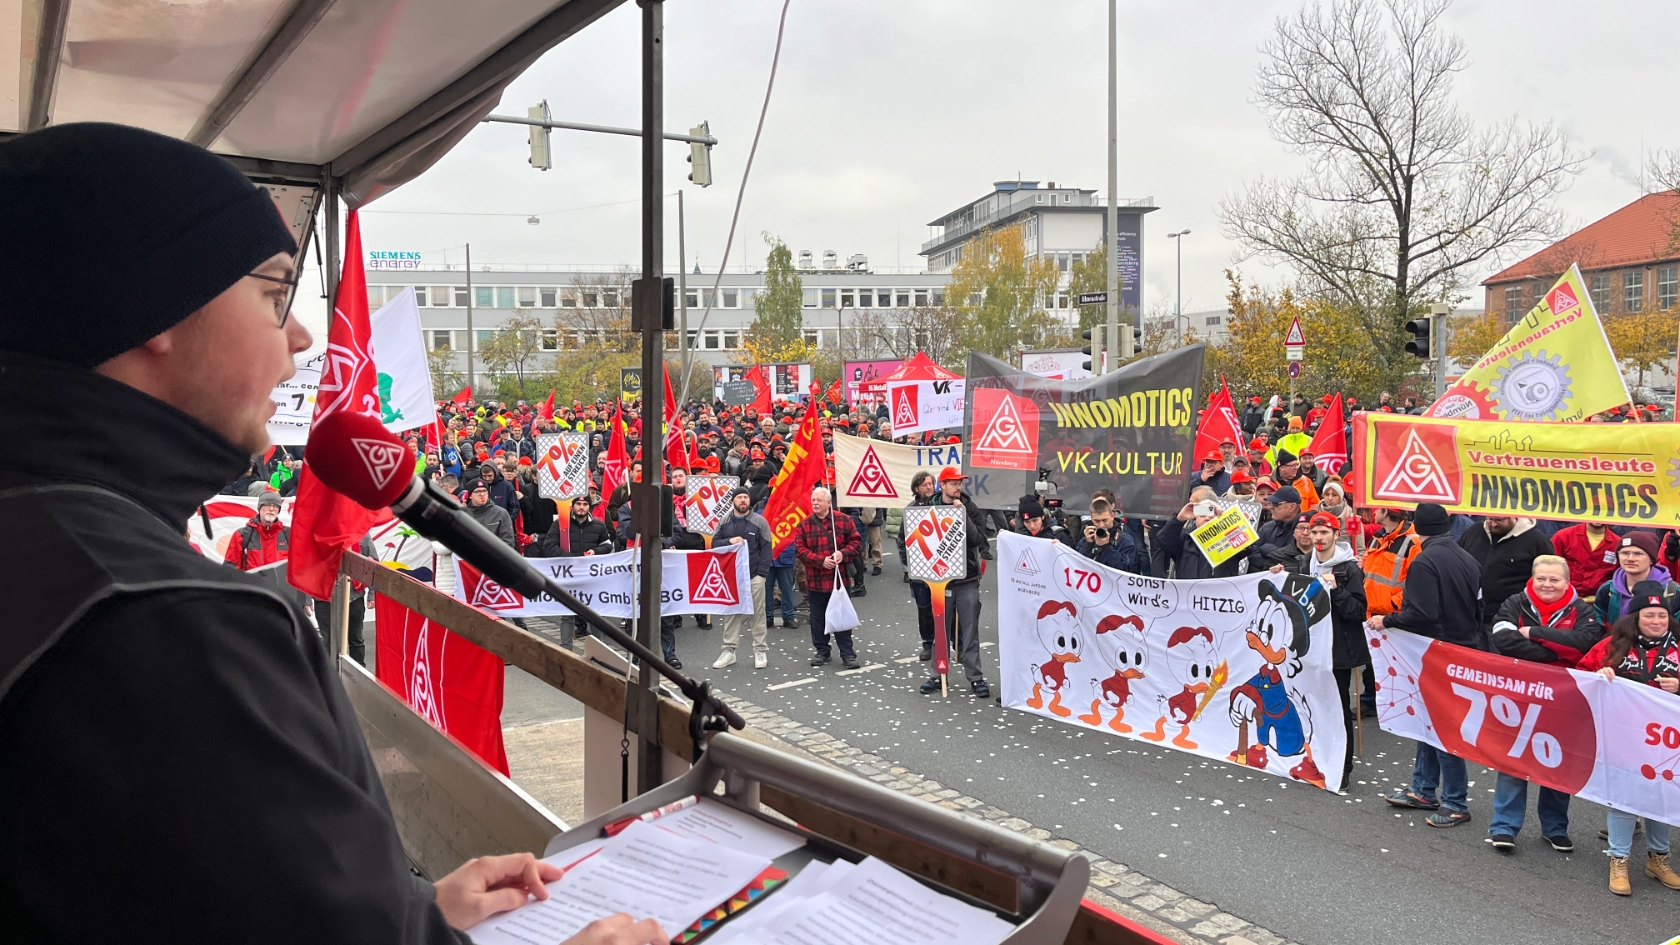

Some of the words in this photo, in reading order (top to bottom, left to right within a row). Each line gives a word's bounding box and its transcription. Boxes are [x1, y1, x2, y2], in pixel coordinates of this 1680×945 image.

[370, 251, 421, 259] SIEMENS
[370, 260, 421, 268] energy
[933, 380, 953, 395] VK
[1048, 387, 1193, 429] INNOMOTICS
[537, 434, 579, 482] 7%
[562, 462, 574, 478] AUF
[570, 444, 586, 465] EINEN
[567, 455, 588, 482] STREICH
[990, 458, 1018, 468] Nürnberg
[1057, 451, 1183, 476] VK-KULTUR
[1467, 450, 1656, 474] Vertrauensleute
[685, 478, 730, 519] 7%
[712, 502, 723, 515] AUF
[1471, 474, 1659, 518] INNOMOTICS
[905, 508, 955, 562] 7%
[936, 540, 948, 557] AUF
[944, 519, 963, 542] EINEN
[1197, 511, 1242, 544] INNOMOTICS
[1230, 532, 1248, 549] WIR
[942, 530, 965, 562] STREICH
[550, 564, 574, 579] VK
[1064, 567, 1102, 593] 170
[1193, 596, 1245, 613] HITZIG
[1446, 663, 1526, 695] GEMEINSAM
[1527, 681, 1554, 701] FÜR
[1450, 682, 1563, 768] 7%
